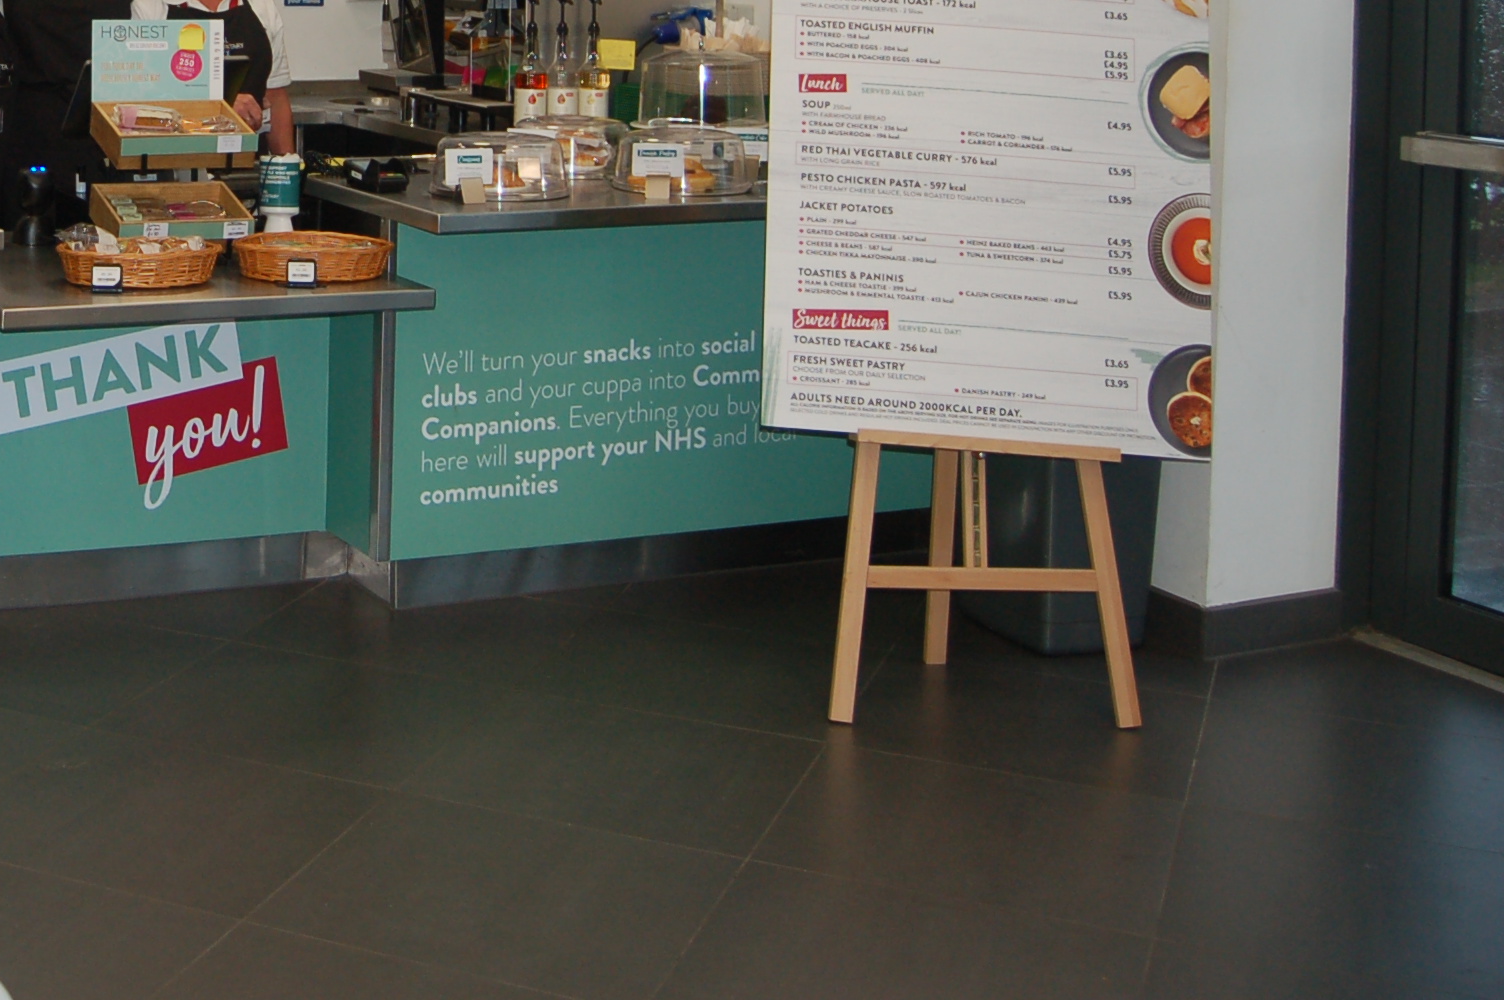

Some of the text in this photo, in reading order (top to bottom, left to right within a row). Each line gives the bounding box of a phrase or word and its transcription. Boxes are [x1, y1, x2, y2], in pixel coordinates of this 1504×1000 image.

[943, 0, 956, 7] 172
[959, 1, 976, 9] kcal
[1105, 12, 1128, 20] £3.65
[101, 25, 168, 42] HONEST
[801, 20, 934, 34] TOASTED ENGLISH MUFFIN
[179, 58, 194, 66] 250
[1104, 61, 1128, 69] £4.95
[801, 74, 843, 92] Lunch
[1105, 71, 1128, 80] £5.95
[802, 100, 830, 109] SOUP
[802, 145, 997, 166] RED THAI VEGETABLE CURRY 576 kcal
[801, 173, 966, 191] PESTO CHICKEN PASTA 597 kcal
[800, 201, 893, 214] JACKET POTATOES
[1109, 250, 1132, 259] £5.75
[799, 268, 904, 282] TOASTIES & PANINIS
[795, 309, 887, 330] Sweet things
[794, 335, 937, 353] TOASTED TEACAKE 256 kcal
[424, 331, 755, 376] We'll turn your snacks into social
[794, 355, 905, 370] FRESH SWEET PASTRY
[2, 325, 228, 418] THANK
[422, 365, 759, 407] clubs and your cuppa into Comm
[1105, 379, 1128, 388] £3.95
[791, 393, 1022, 417] ADULTS NEED AROUND 2000KCAL PER DAY.
[422, 395, 760, 443] Companions. Everything you buy
[144, 365, 265, 509] you!
[422, 452, 468, 472] here
[477, 445, 507, 467] will
[515, 437, 595, 470] support
[602, 437, 647, 465] your
[655, 428, 705, 452] NHS
[713, 426, 746, 447] and
[421, 475, 558, 504] communities
